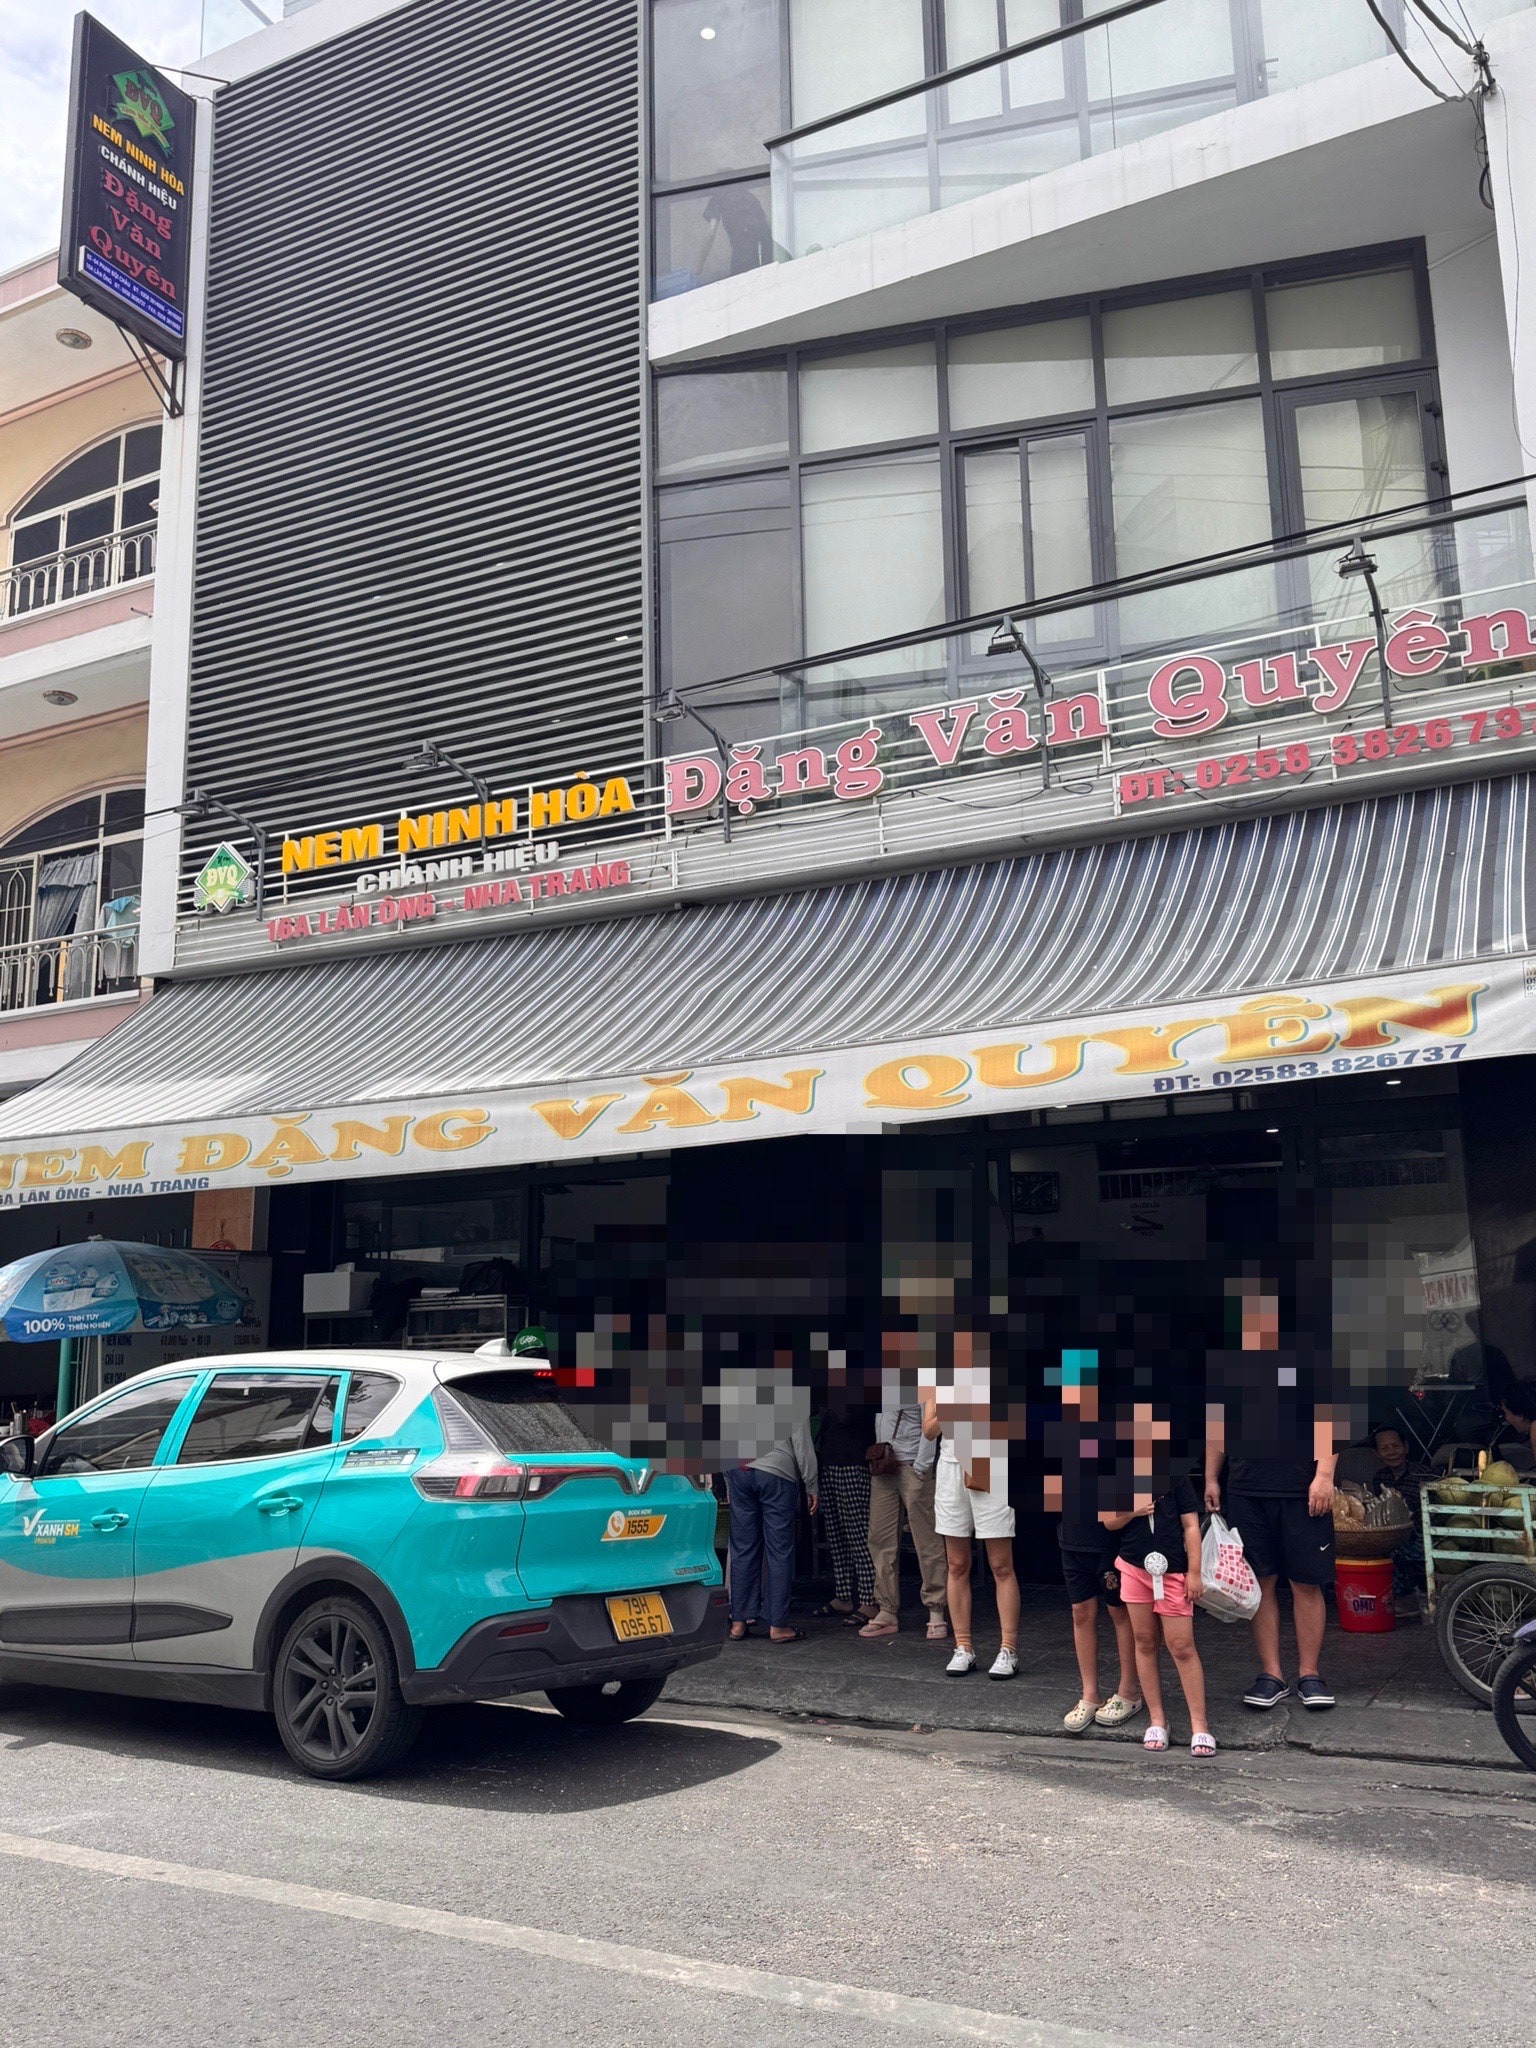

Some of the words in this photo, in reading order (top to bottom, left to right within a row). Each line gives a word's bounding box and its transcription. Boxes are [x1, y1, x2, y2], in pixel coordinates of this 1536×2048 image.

[92, 114, 123, 148] NEM
[125, 139, 157, 174] NINH
[160, 166, 185, 196] HÒA
[101, 145, 146, 187] CHÁNH
[148, 180, 177, 210] HIỆU
[103, 169, 173, 240] Đặng
[109, 205, 162, 260] Văn
[90, 225, 176, 300] Quyên
[665, 727, 885, 816] Đặng
[910, 690, 1109, 767] Văn
[1148, 608, 1536, 738] Quyên
[1119, 768, 1184, 804] ĐT:
[1195, 743, 1311, 789] 0258
[282, 823, 383, 873] NEM
[398, 798, 517, 853] NINH
[531, 771, 637, 829] HÒA
[356, 856, 474, 894] CHÁNH
[483, 840, 559, 873] HIỆU
[265, 914, 311, 942] 16A
[379, 893, 437, 924] ÔNG
[464, 880, 523, 911] NHA
[528, 861, 631, 900] TRANG
[175, 1110, 498, 1176] ĐẶNG
[530, 1069, 826, 1140] VĂN
[863, 983, 1490, 1112] QUYÊN
[1153, 1074, 1201, 1093] ĐT:
[1212, 1043, 1467, 1087] 02583.826737
[55, 1187, 90, 1200] ÔNG
[108, 1182, 144, 1197] NHA
[150, 1177, 209, 1193] TRANG
[23, 1317, 65, 1334] 100%
[36, 1523, 64, 1537] XANH
[64, 1523, 80, 1536] SM
[627, 1519, 650, 1535] 1555
[620, 1614, 664, 1637] 095.67
[622, 1596, 650, 1616] 79H
